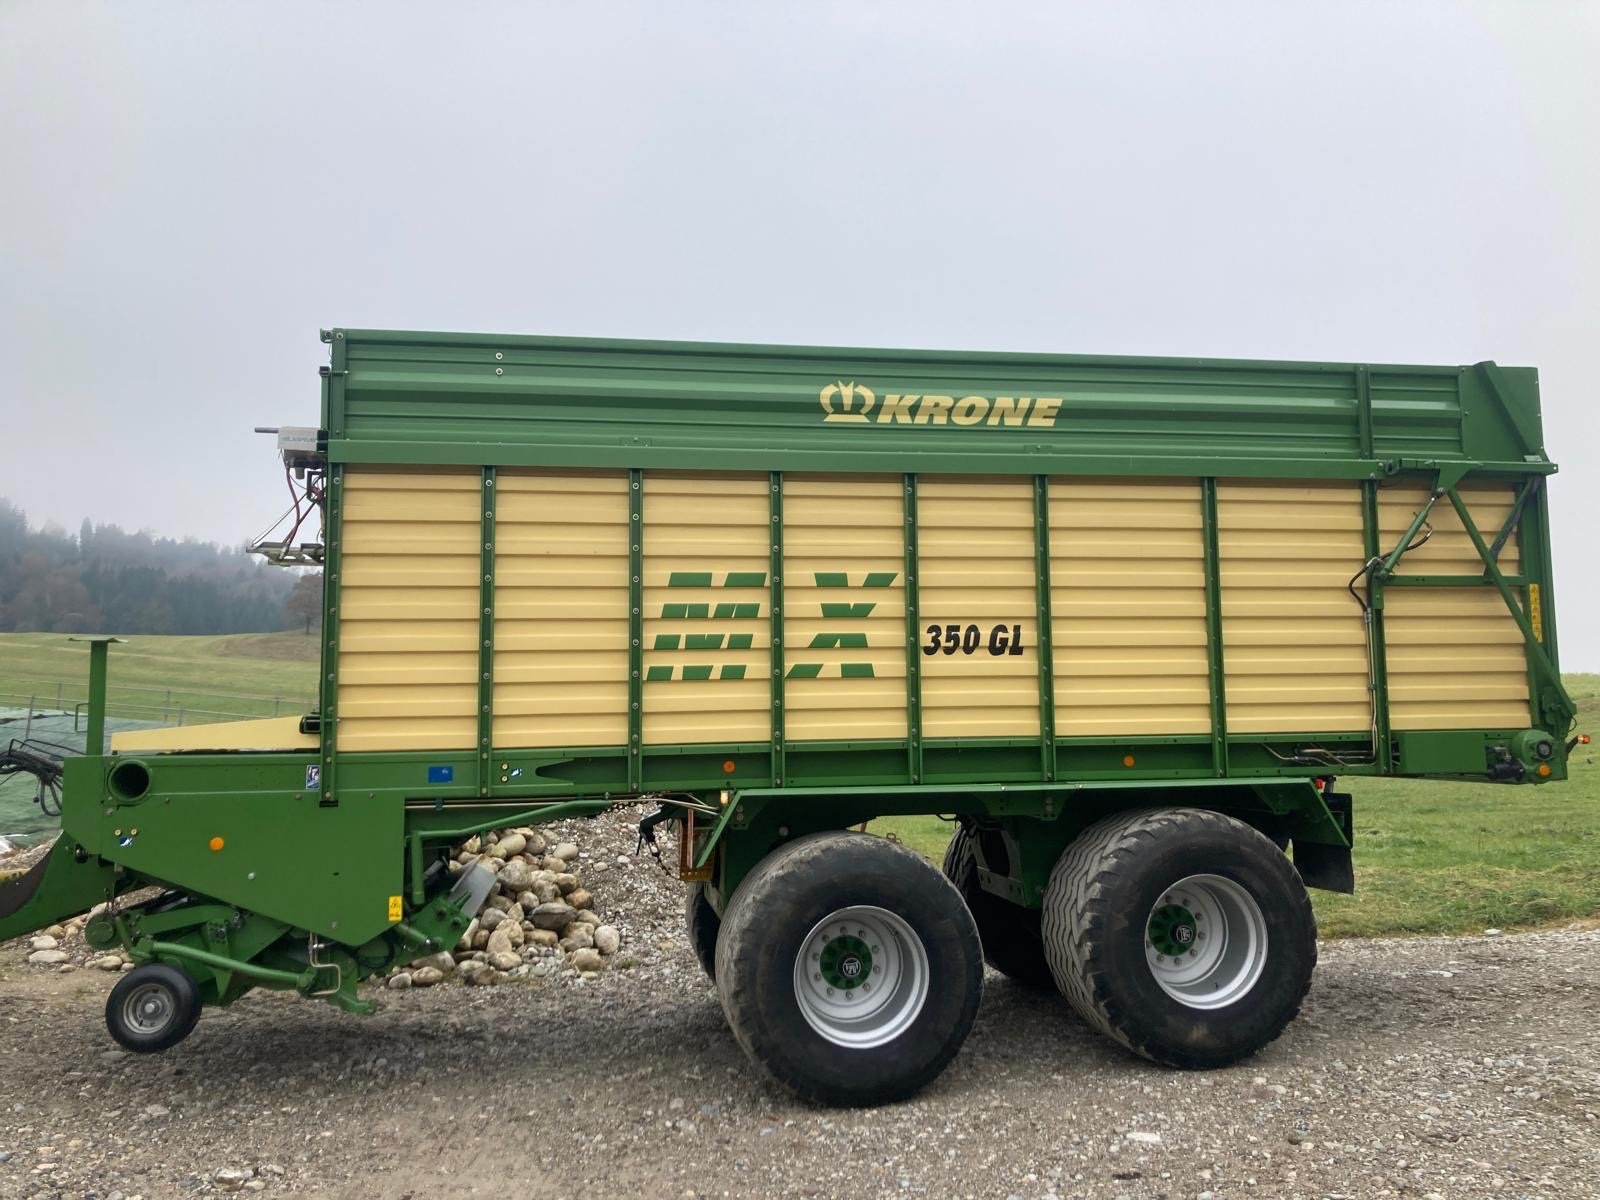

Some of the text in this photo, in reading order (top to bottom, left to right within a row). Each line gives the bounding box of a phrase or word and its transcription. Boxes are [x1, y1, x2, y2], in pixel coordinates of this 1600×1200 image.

[877, 395, 1063, 426] KRONE
[923, 624, 980, 656] 350
[988, 624, 1024, 656] GL
